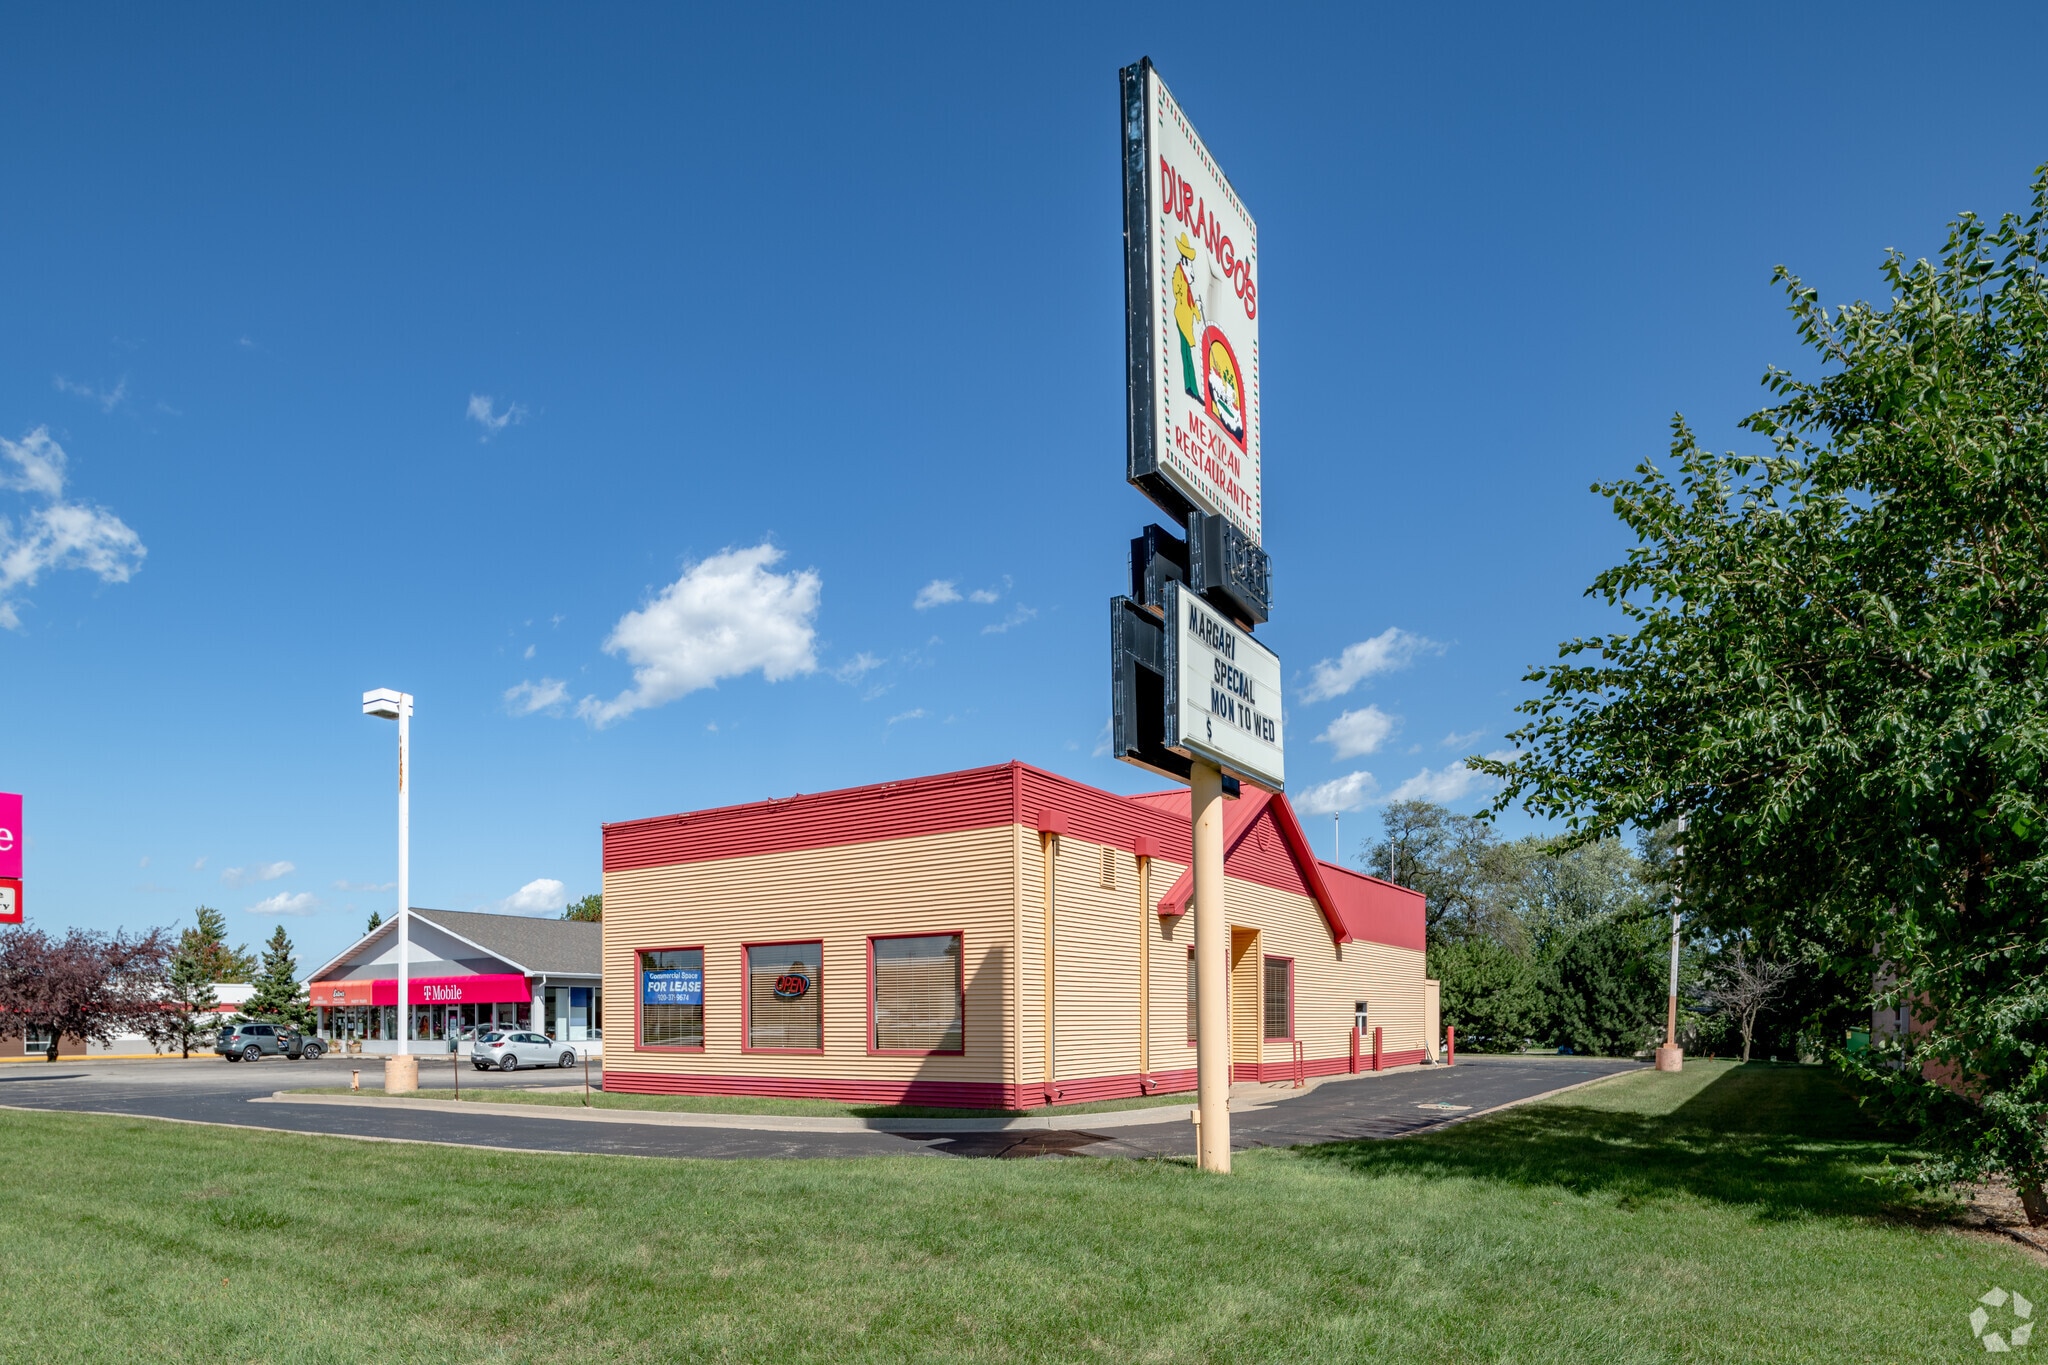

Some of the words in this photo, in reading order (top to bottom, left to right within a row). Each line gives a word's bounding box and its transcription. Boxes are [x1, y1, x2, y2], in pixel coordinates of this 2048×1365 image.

[1160, 154, 1256, 320] DURANGO'S
[1189, 410, 1240, 479] MEXICAN
[1175, 425, 1252, 519] RESTAURANTE
[1189, 604, 1235, 661] MARGARI
[1214, 658, 1255, 705] SPECIAL
[1206, 717, 1213, 742] $
[1211, 687, 1235, 723] MON
[1237, 703, 1251, 731] TO
[1253, 711, 1275, 743] WED
[432, 985, 462, 1000] Mobile
[647, 981, 667, 992] FOR
[669, 981, 702, 992] LEASE
[649, 972, 681, 980] Commercial
[681, 971, 698, 980] Space
[775, 975, 806, 994] OPEN
